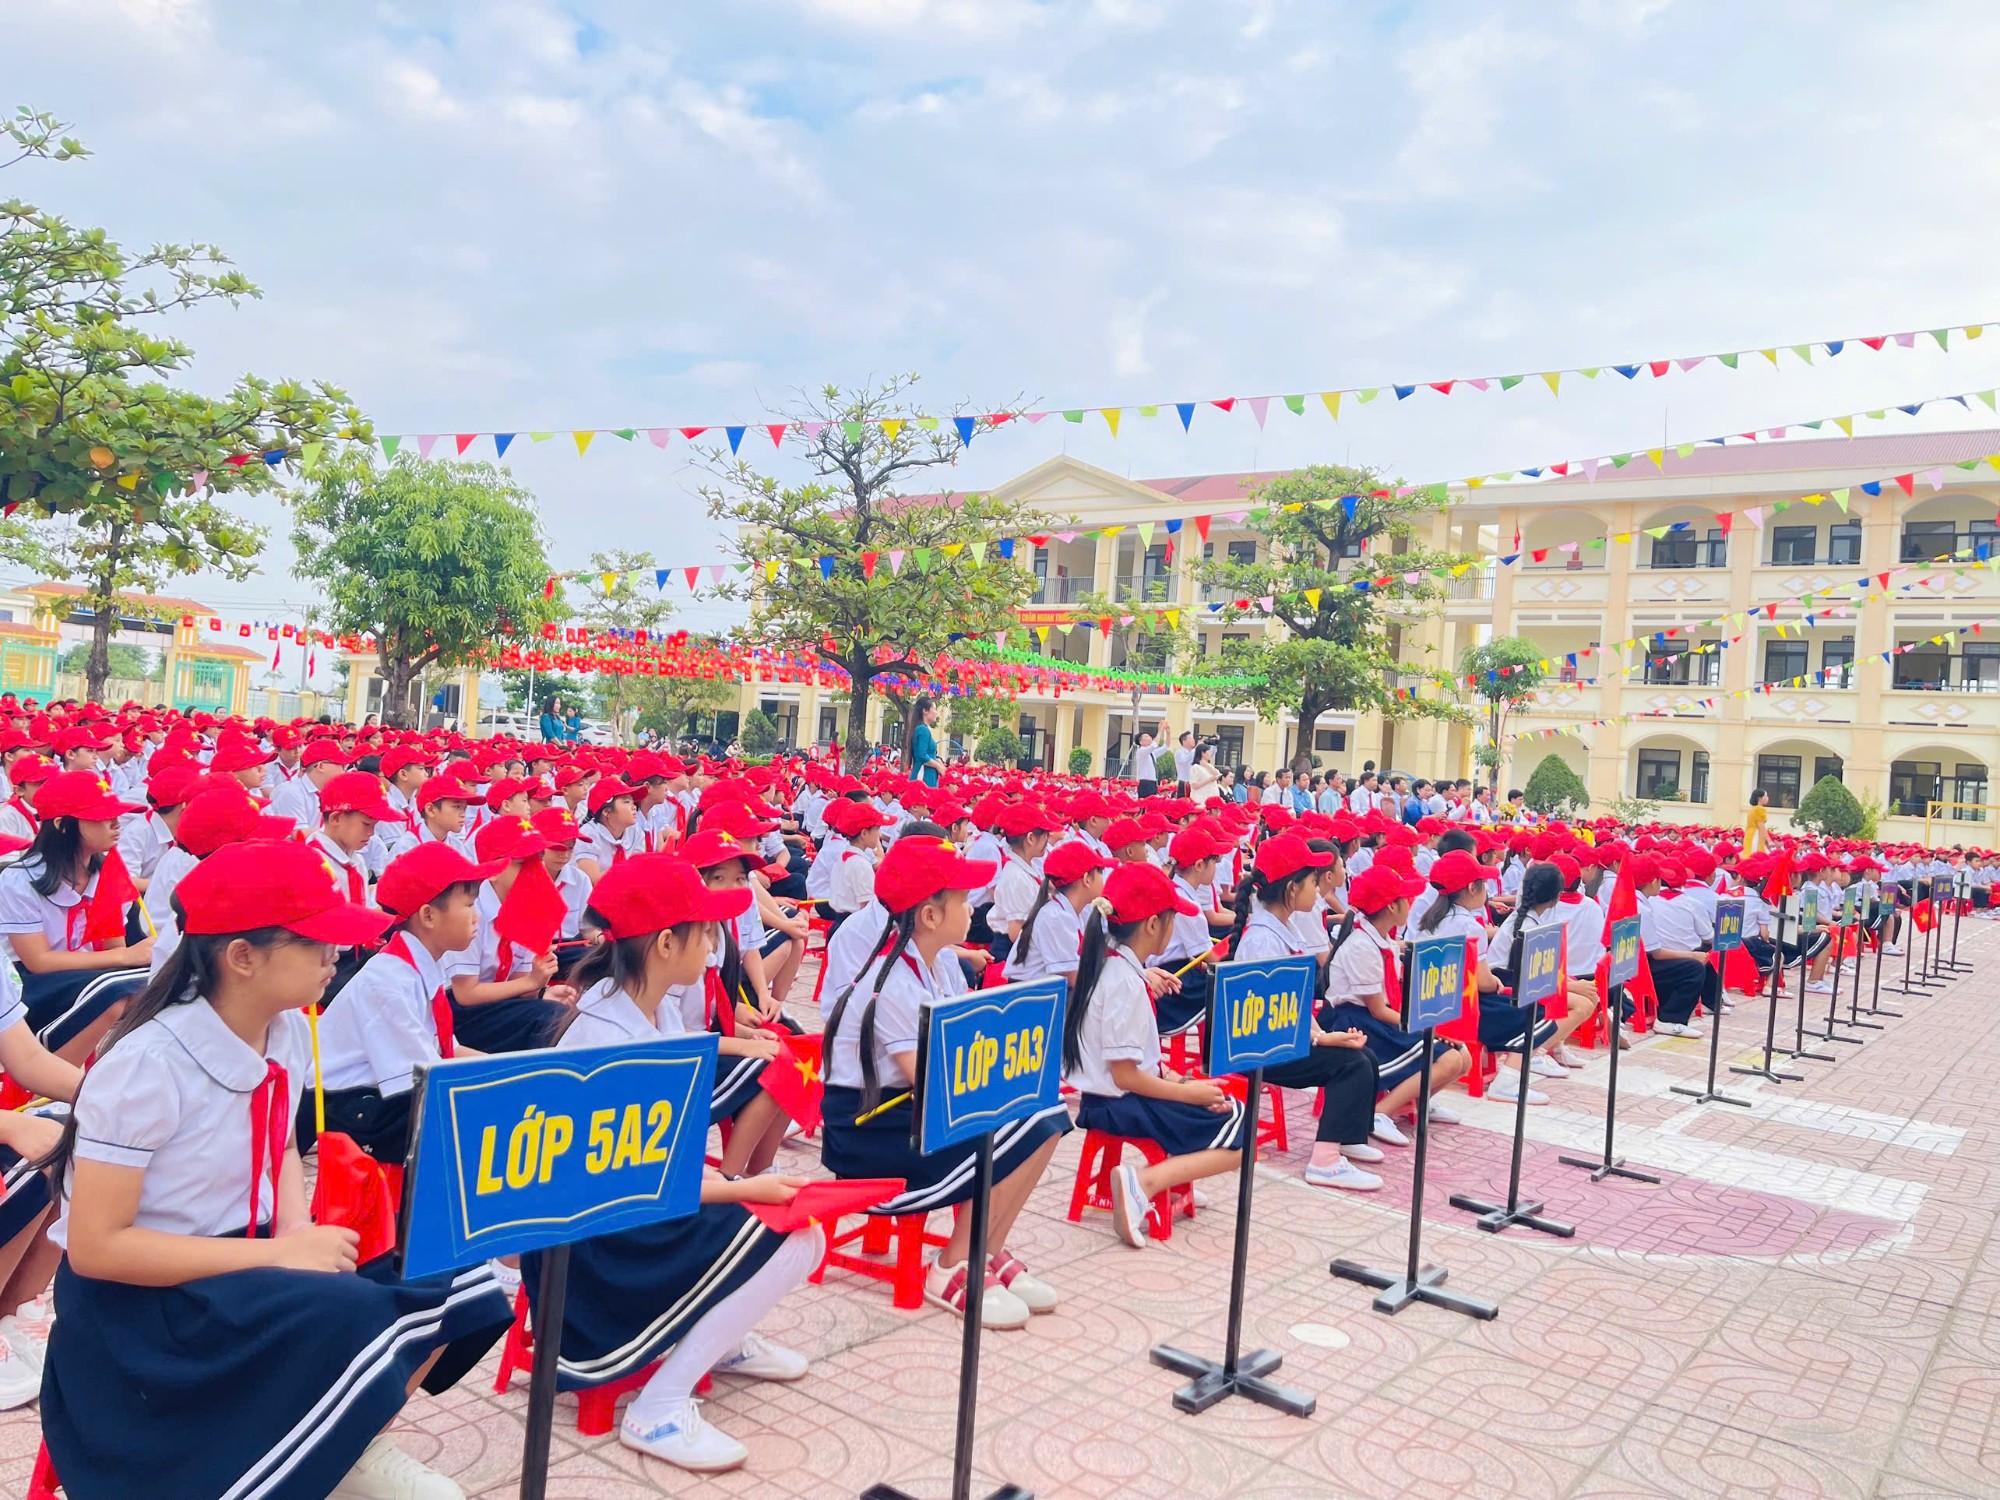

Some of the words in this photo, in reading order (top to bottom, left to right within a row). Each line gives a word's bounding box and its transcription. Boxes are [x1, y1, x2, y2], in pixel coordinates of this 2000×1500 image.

[1528, 947, 1542, 979] LỚP
[1616, 936, 1626, 965] LỚP
[1421, 961, 1439, 1000] LỚP
[1440, 964, 1457, 996] 5A5
[1232, 990, 1264, 1038] LỚP
[1268, 991, 1298, 1030] 5A4
[953, 1030, 998, 1096] LỚP
[1003, 1025, 1044, 1080] 5A3
[476, 1104, 573, 1195] LỚP
[586, 1100, 672, 1174] 5A2
